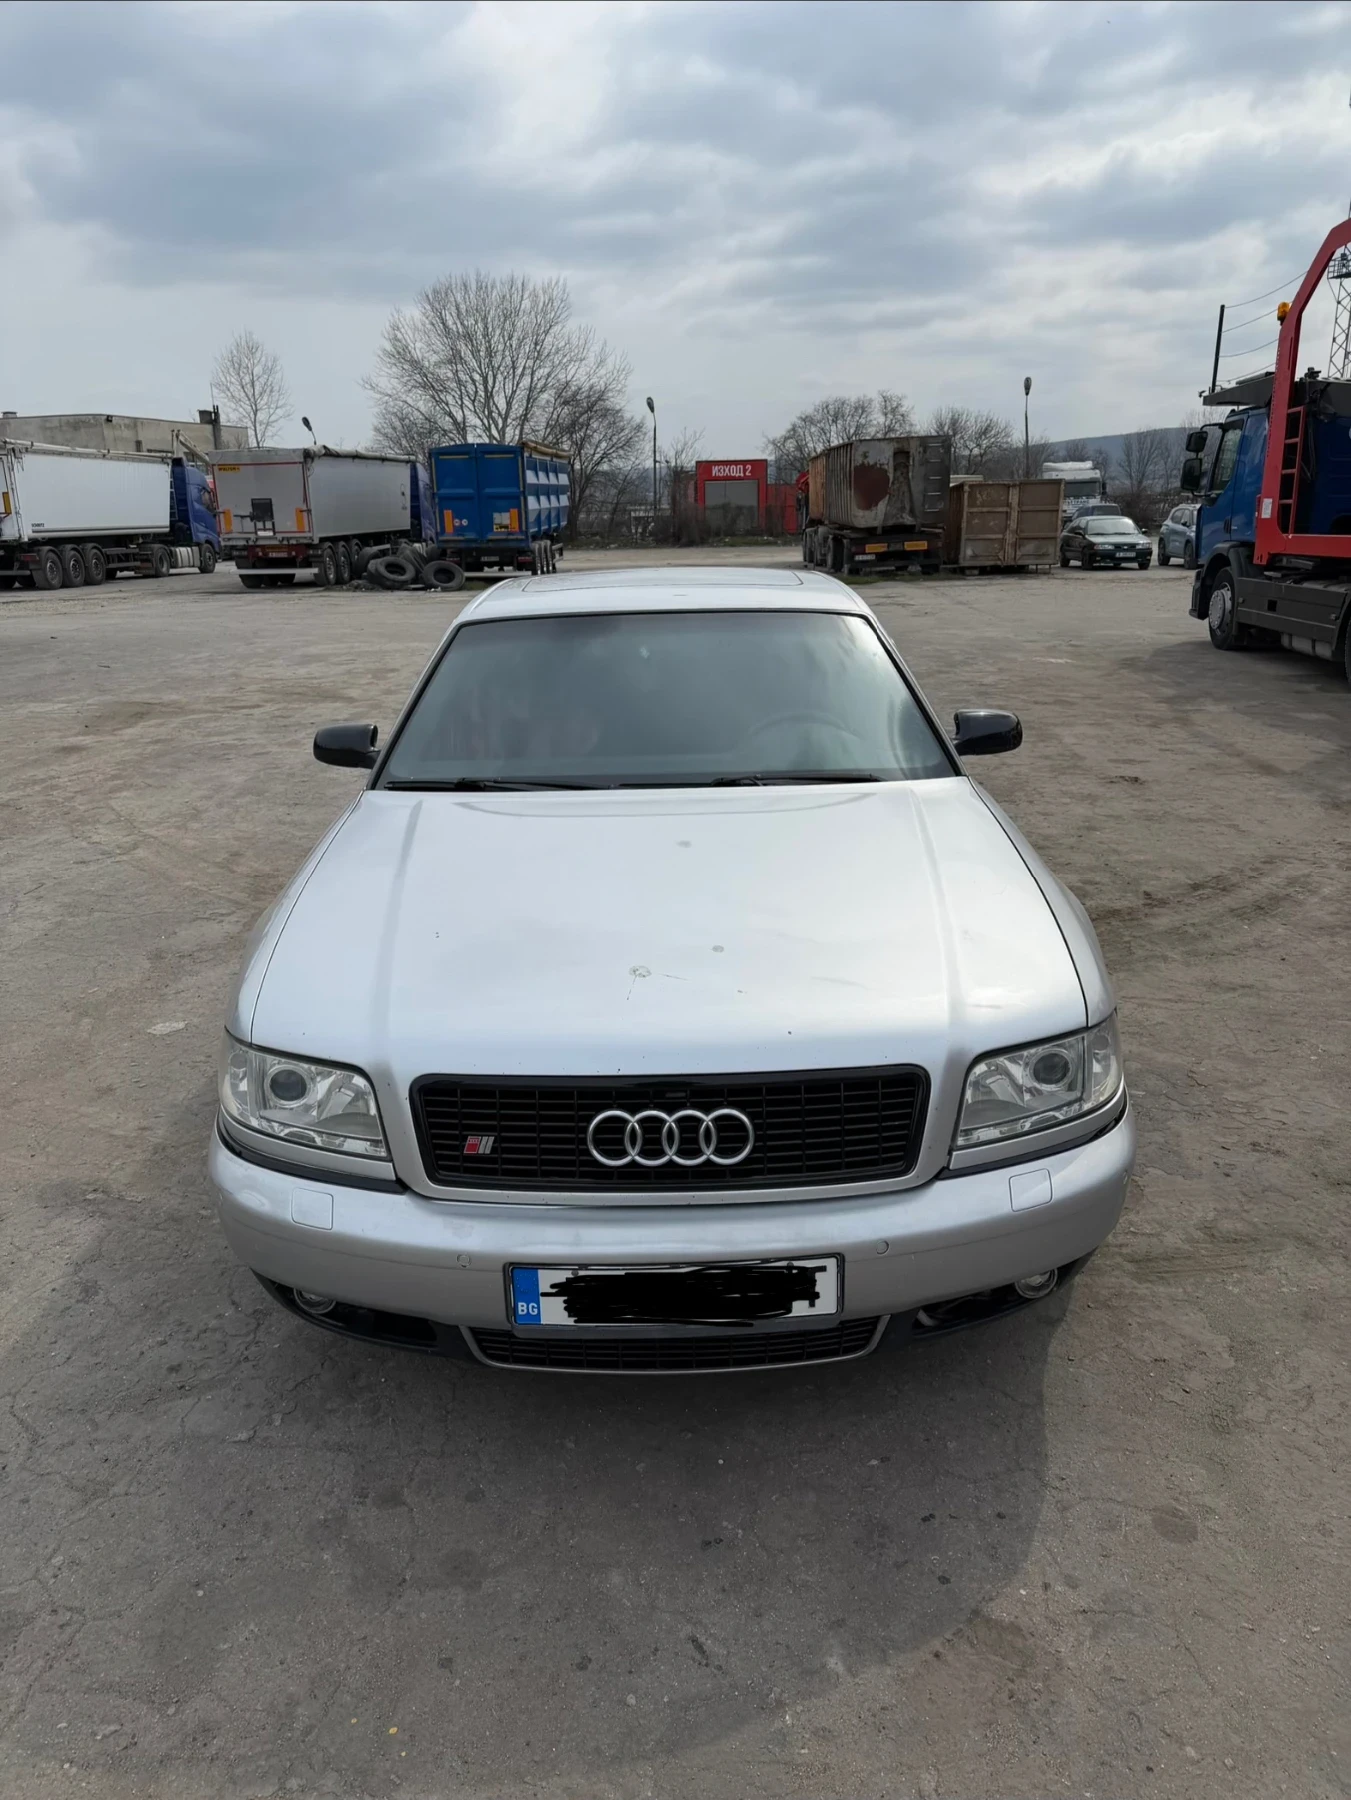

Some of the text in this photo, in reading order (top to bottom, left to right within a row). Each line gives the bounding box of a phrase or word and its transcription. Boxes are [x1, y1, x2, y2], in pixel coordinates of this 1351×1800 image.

[712, 464, 752, 477] ИЗХОД 2
[517, 1302, 538, 1315] BG
